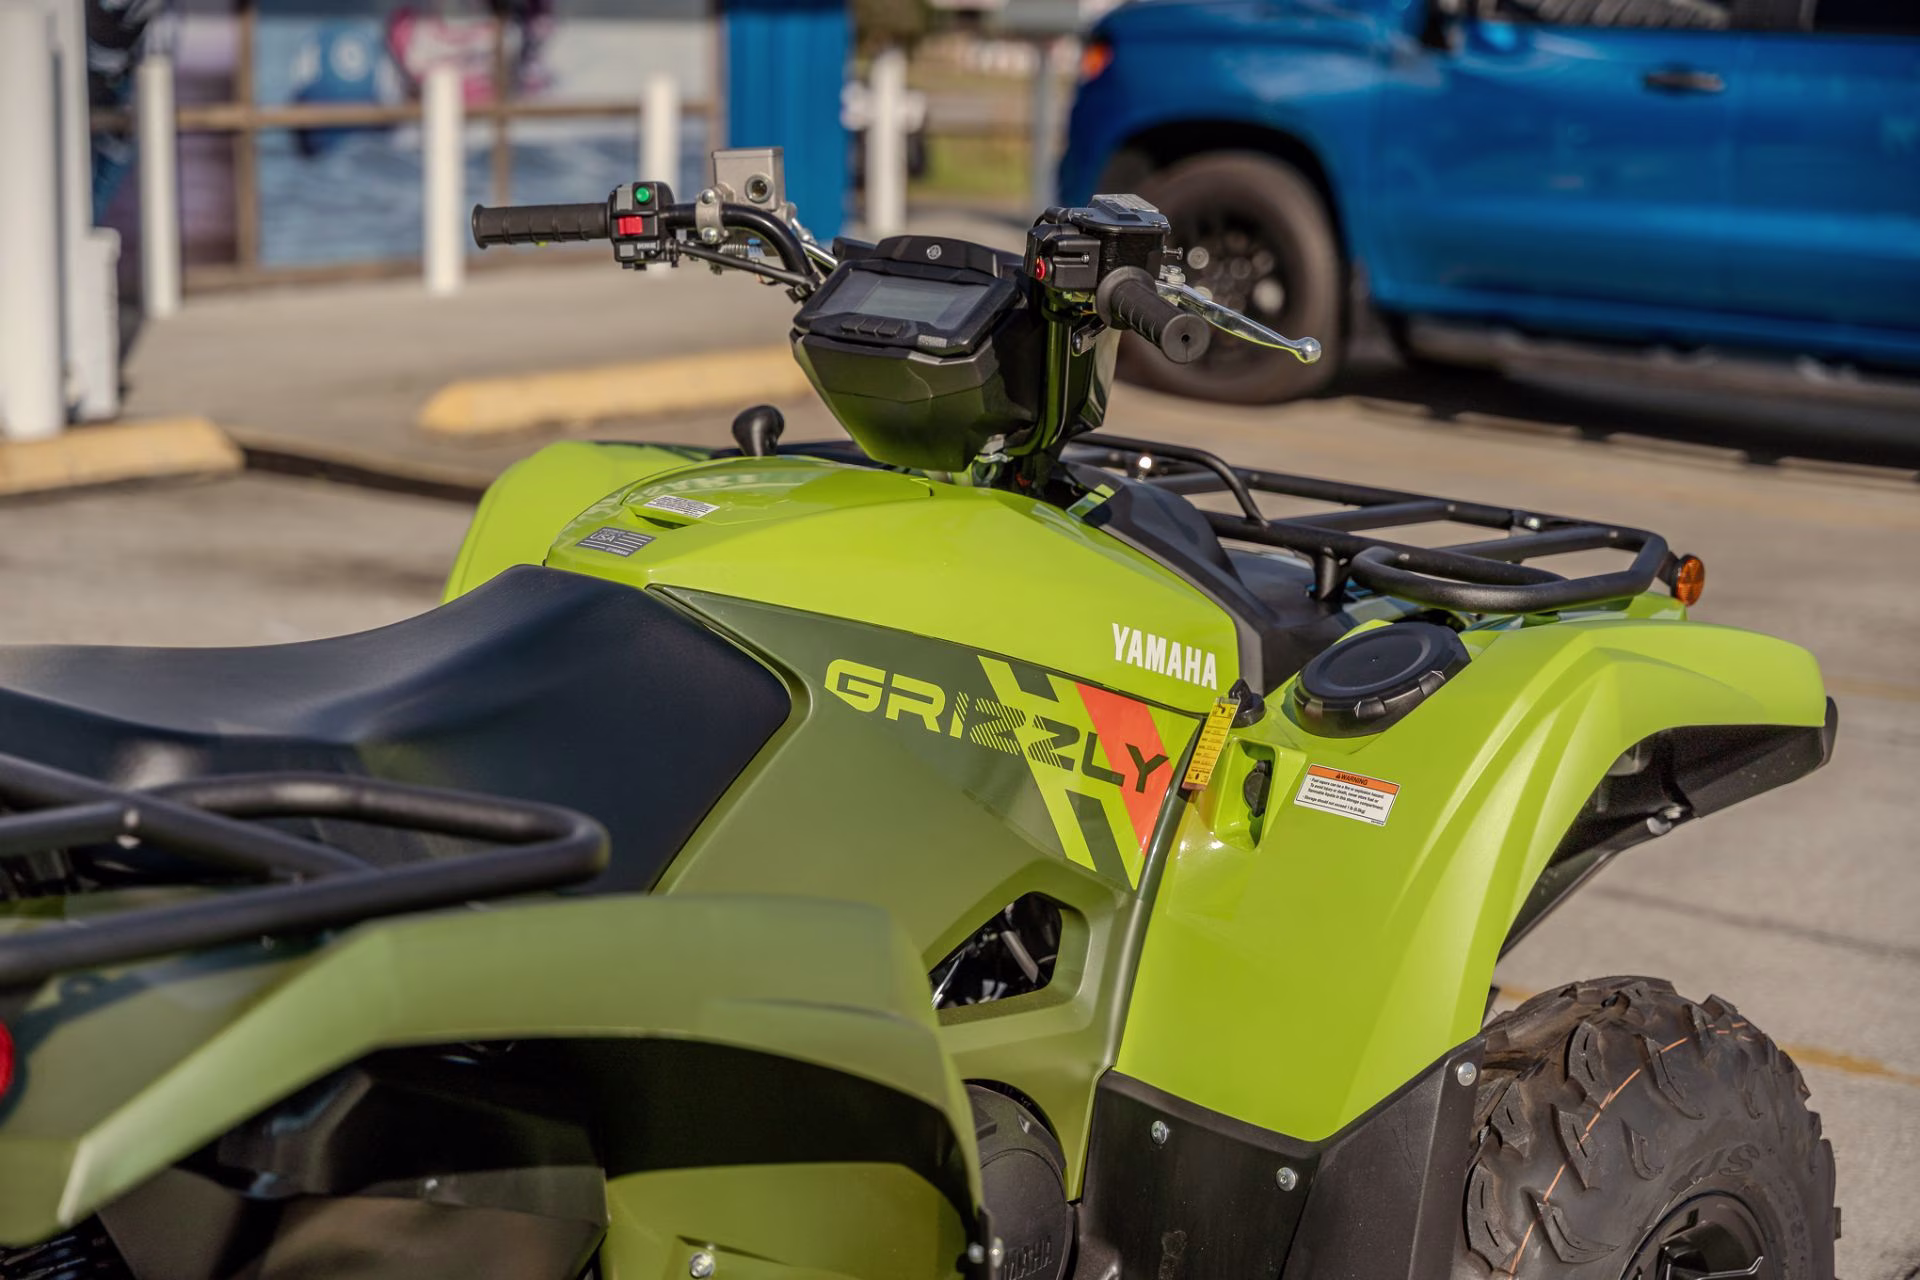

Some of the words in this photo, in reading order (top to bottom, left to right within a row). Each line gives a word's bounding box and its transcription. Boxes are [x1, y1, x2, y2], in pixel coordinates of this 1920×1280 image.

[590, 532, 615, 542] USA
[1111, 623, 1218, 691] YAMAHA
[824, 658, 1170, 794] GRIZZLY
[1341, 774, 1368, 785] WARNING
